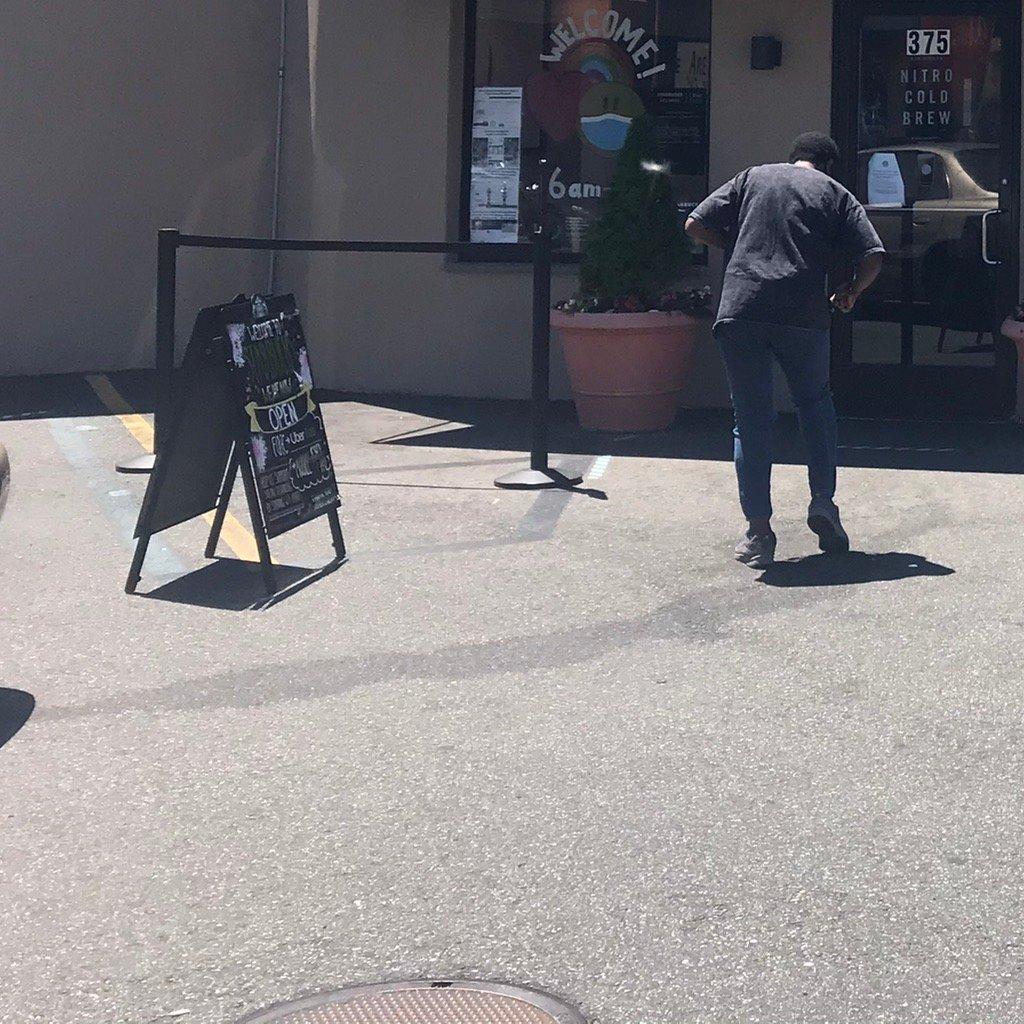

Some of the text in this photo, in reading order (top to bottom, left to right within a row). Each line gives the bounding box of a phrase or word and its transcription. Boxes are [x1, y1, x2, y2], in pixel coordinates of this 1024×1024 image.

[539, 8, 666, 80] WELCOME!
[908, 31, 948, 54] 375
[900, 69, 953, 83] NITRO
[904, 90, 948, 104] COLD
[902, 111, 951, 126] BREW
[268, 400, 299, 430] OPEN
